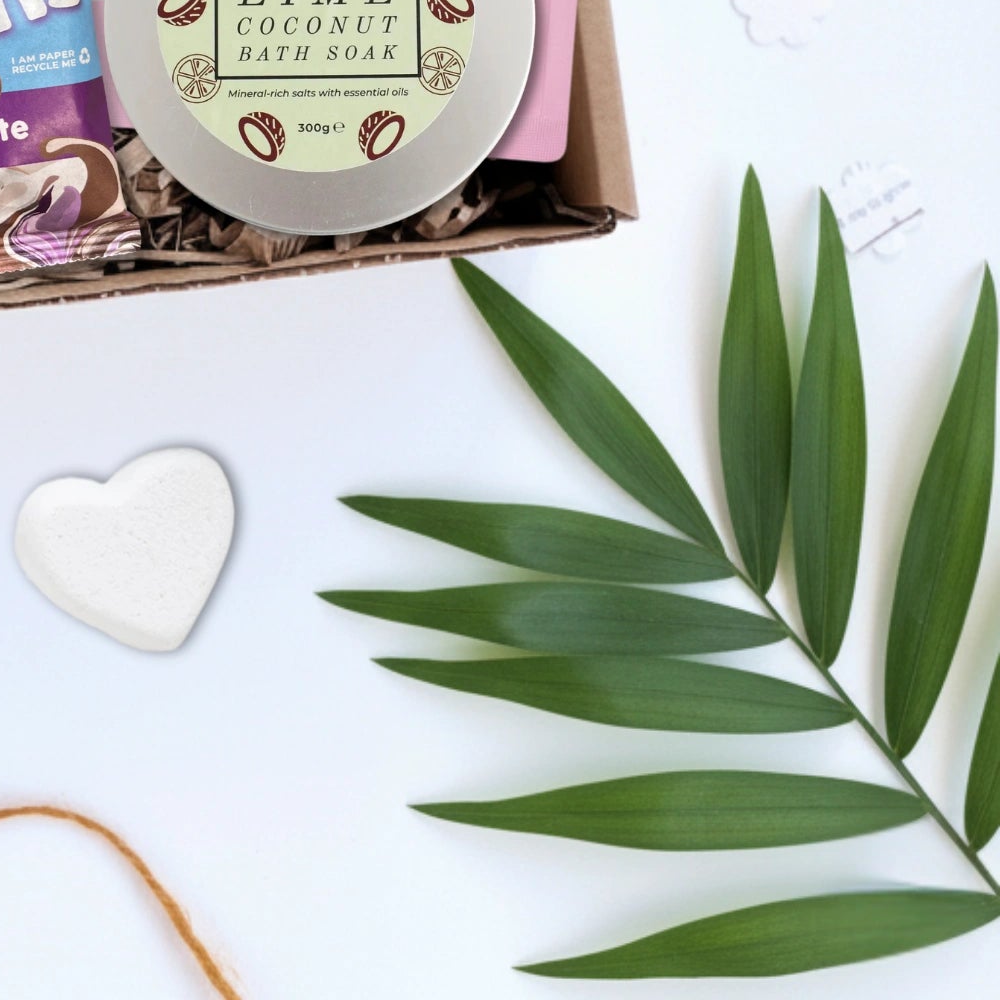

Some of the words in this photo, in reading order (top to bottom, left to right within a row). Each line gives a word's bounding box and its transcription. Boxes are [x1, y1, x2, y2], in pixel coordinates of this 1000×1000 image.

[236, 15, 398, 36] COCONUT
[18, 54, 36, 64] AM
[39, 49, 75, 61] PAPER
[237, 45, 311, 62] BATH
[327, 44, 399, 61] SOAK
[12, 60, 60, 74] RECYCLE
[61, 58, 77, 68] ME
[227, 88, 289, 98] Mineral-rich
[291, 88, 316, 98] salts
[318, 87, 341, 97] with
[343, 87, 390, 97] essential
[391, 87, 409, 97] oils
[297, 123, 330, 135] 300g
